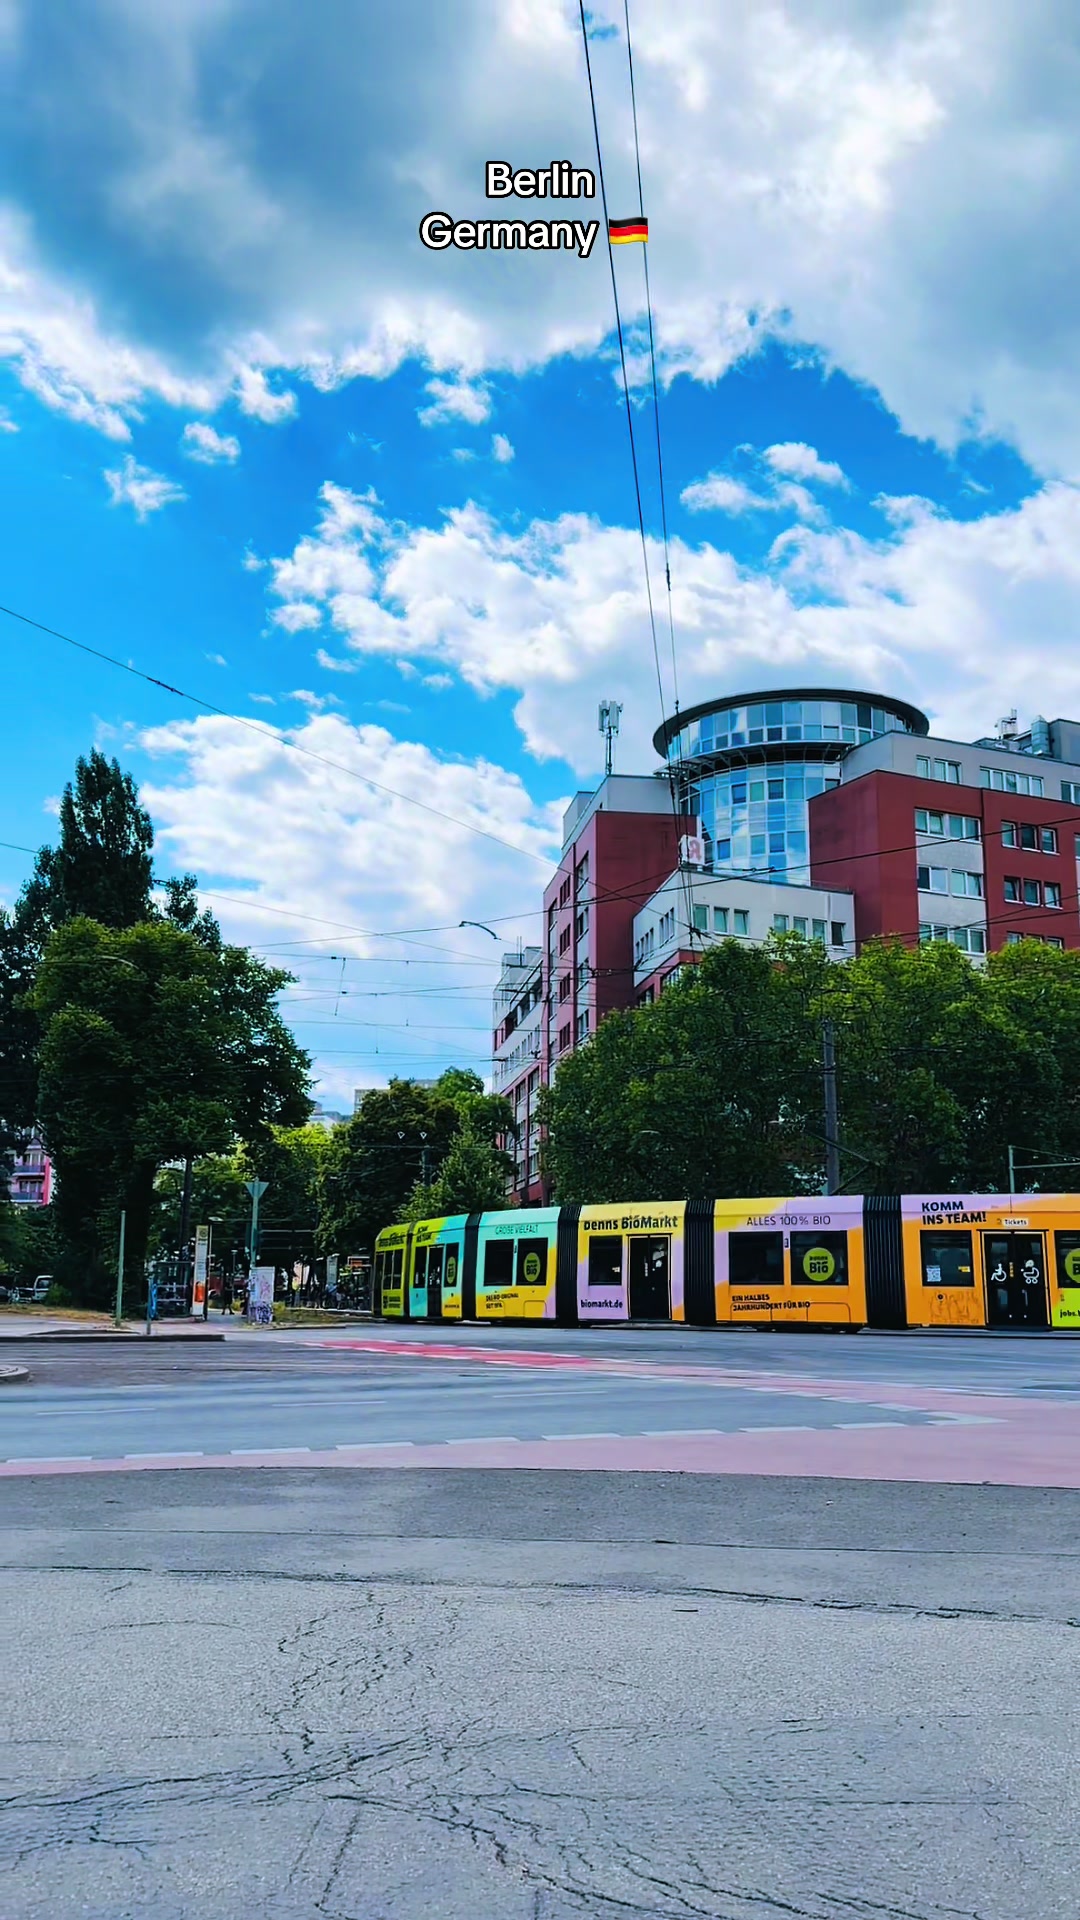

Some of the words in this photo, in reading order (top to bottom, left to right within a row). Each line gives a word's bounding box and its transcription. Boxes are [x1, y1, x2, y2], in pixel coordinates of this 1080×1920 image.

[921, 1201, 964, 1212] KOMM
[746, 1216, 777, 1226] ALLES
[812, 1215, 831, 1225] BIO
[922, 1214, 944, 1225] INS
[945, 1211, 987, 1224] TEAM!
[583, 1220, 618, 1230] Denns
[580, 1299, 623, 1309] biomarkt.de
[733, 1302, 782, 1312] JAHRHUNDERT
[784, 1300, 797, 1309] FÜR
[798, 1301, 811, 1309] BIO
